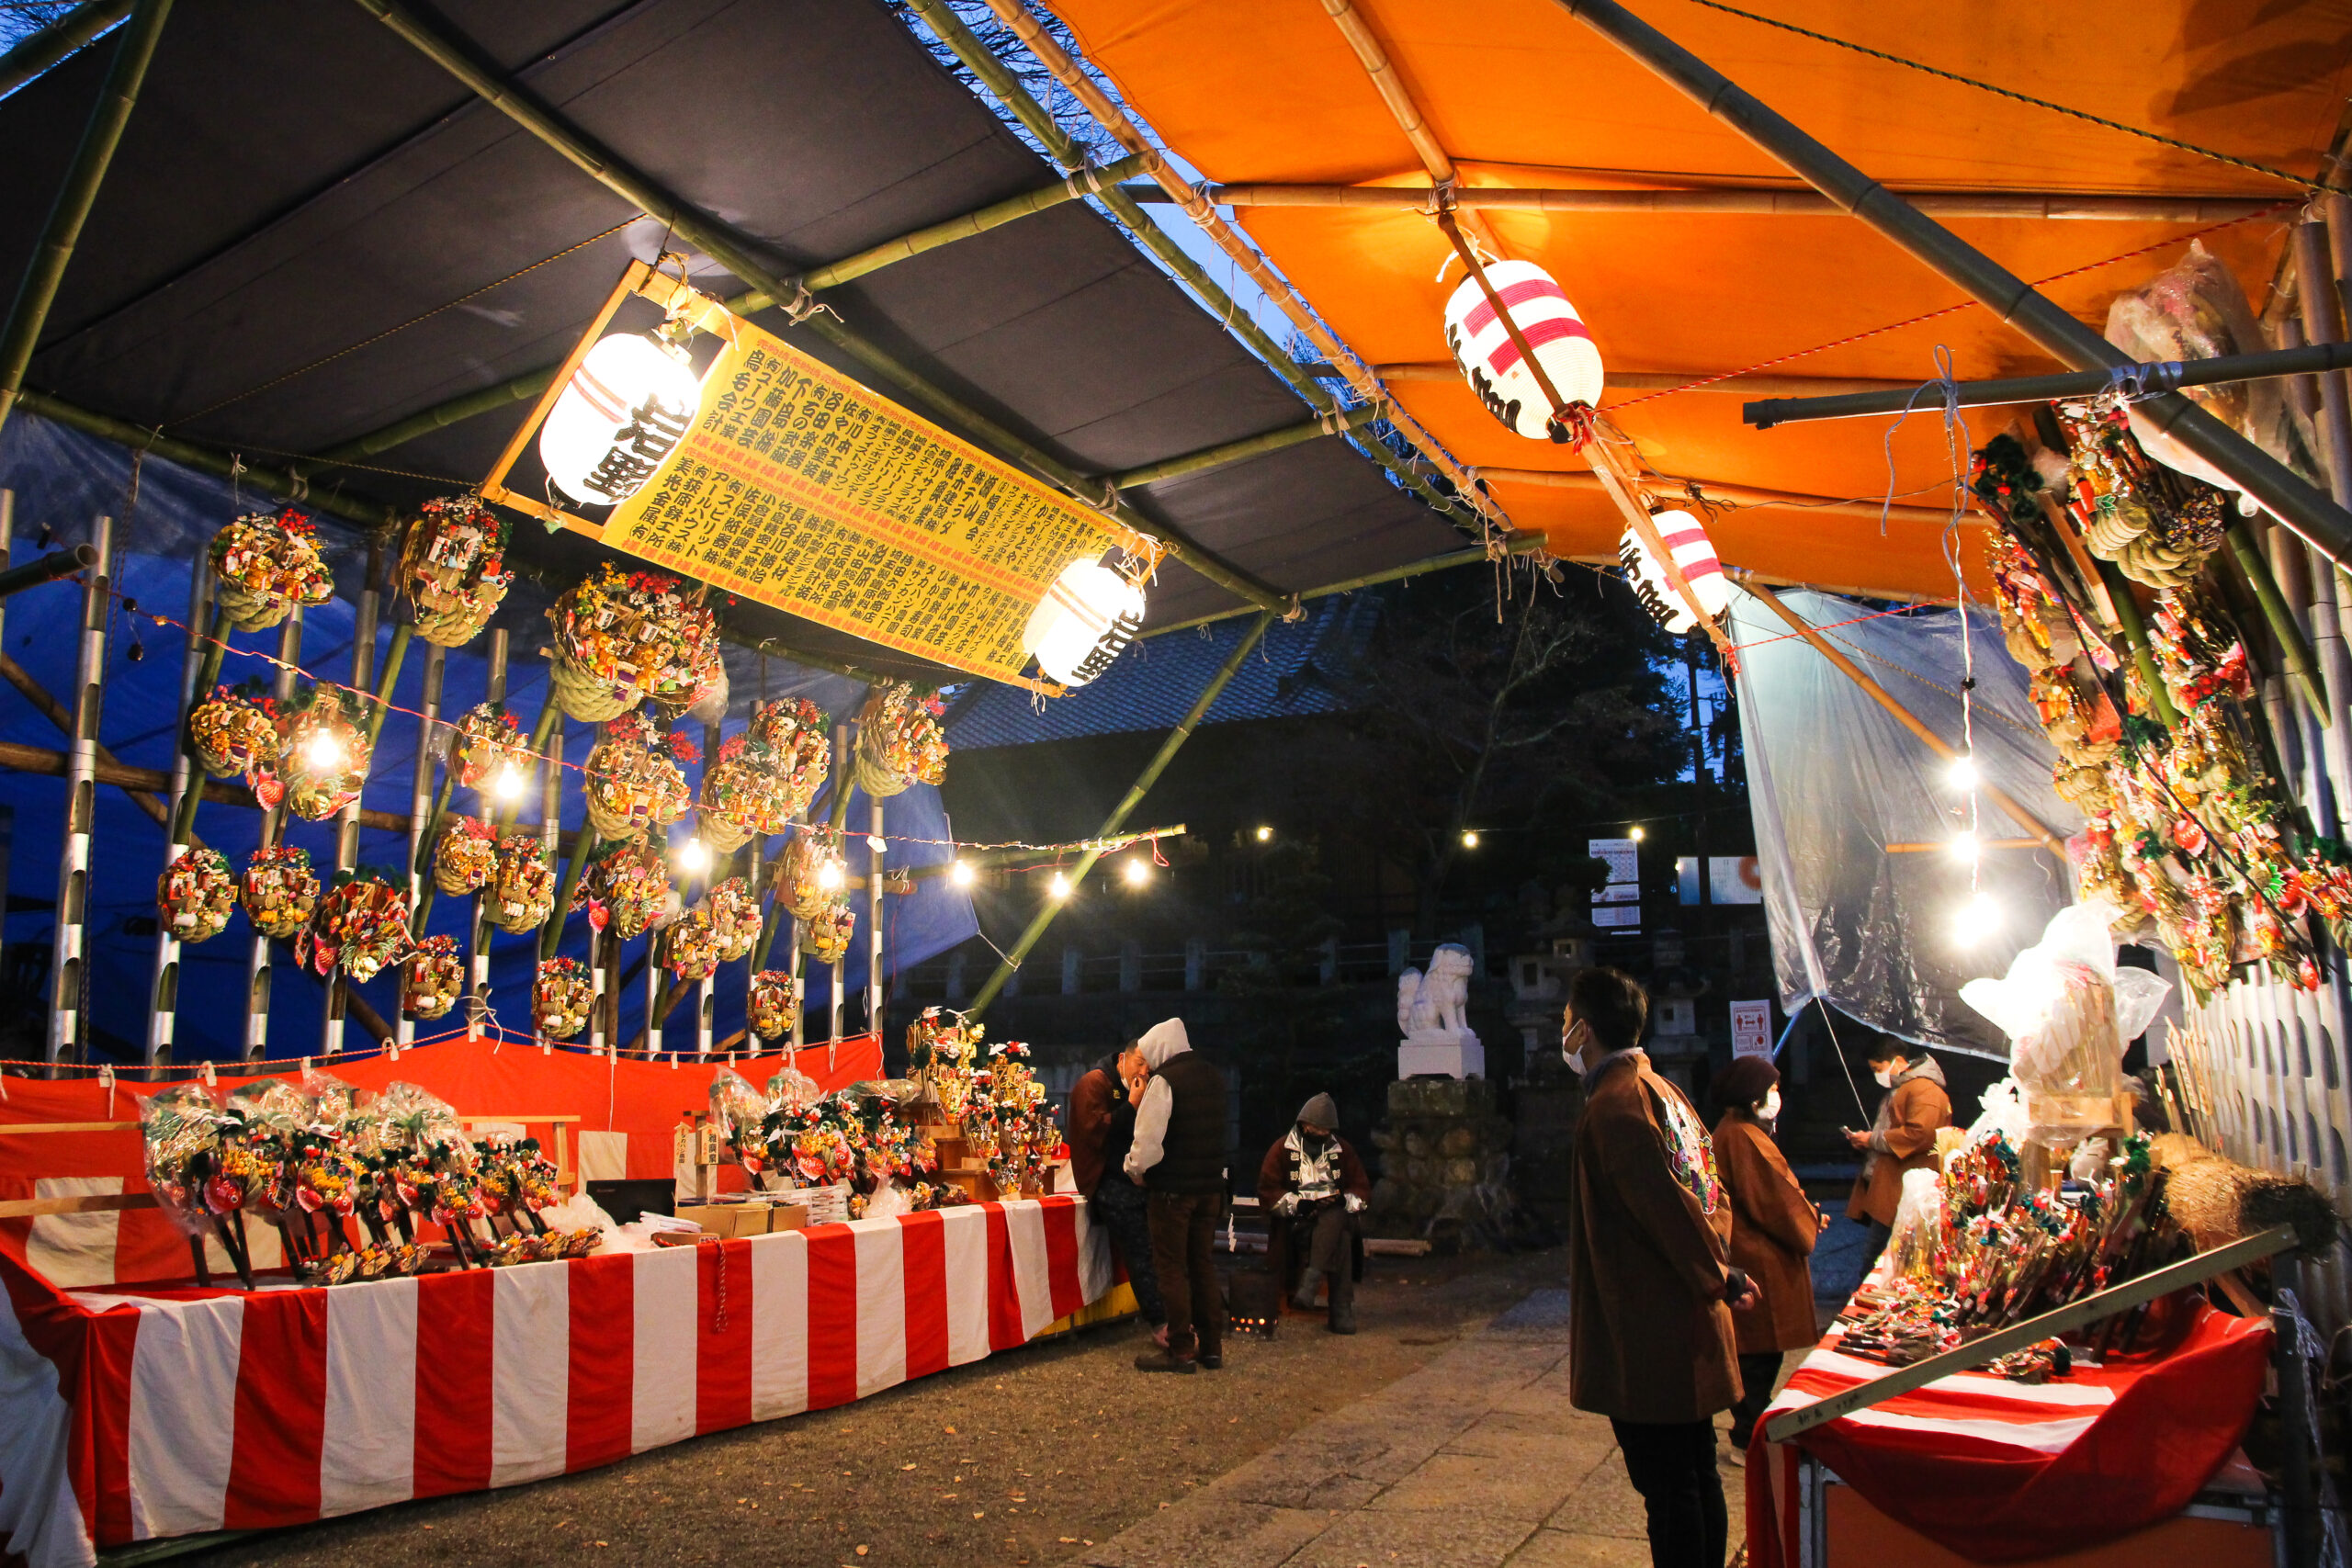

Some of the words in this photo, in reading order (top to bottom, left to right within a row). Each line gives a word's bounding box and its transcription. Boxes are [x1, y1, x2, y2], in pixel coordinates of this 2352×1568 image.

[786, 391, 843, 468] 谷田楽器
[801, 399, 858, 478] 佐々木塗装
